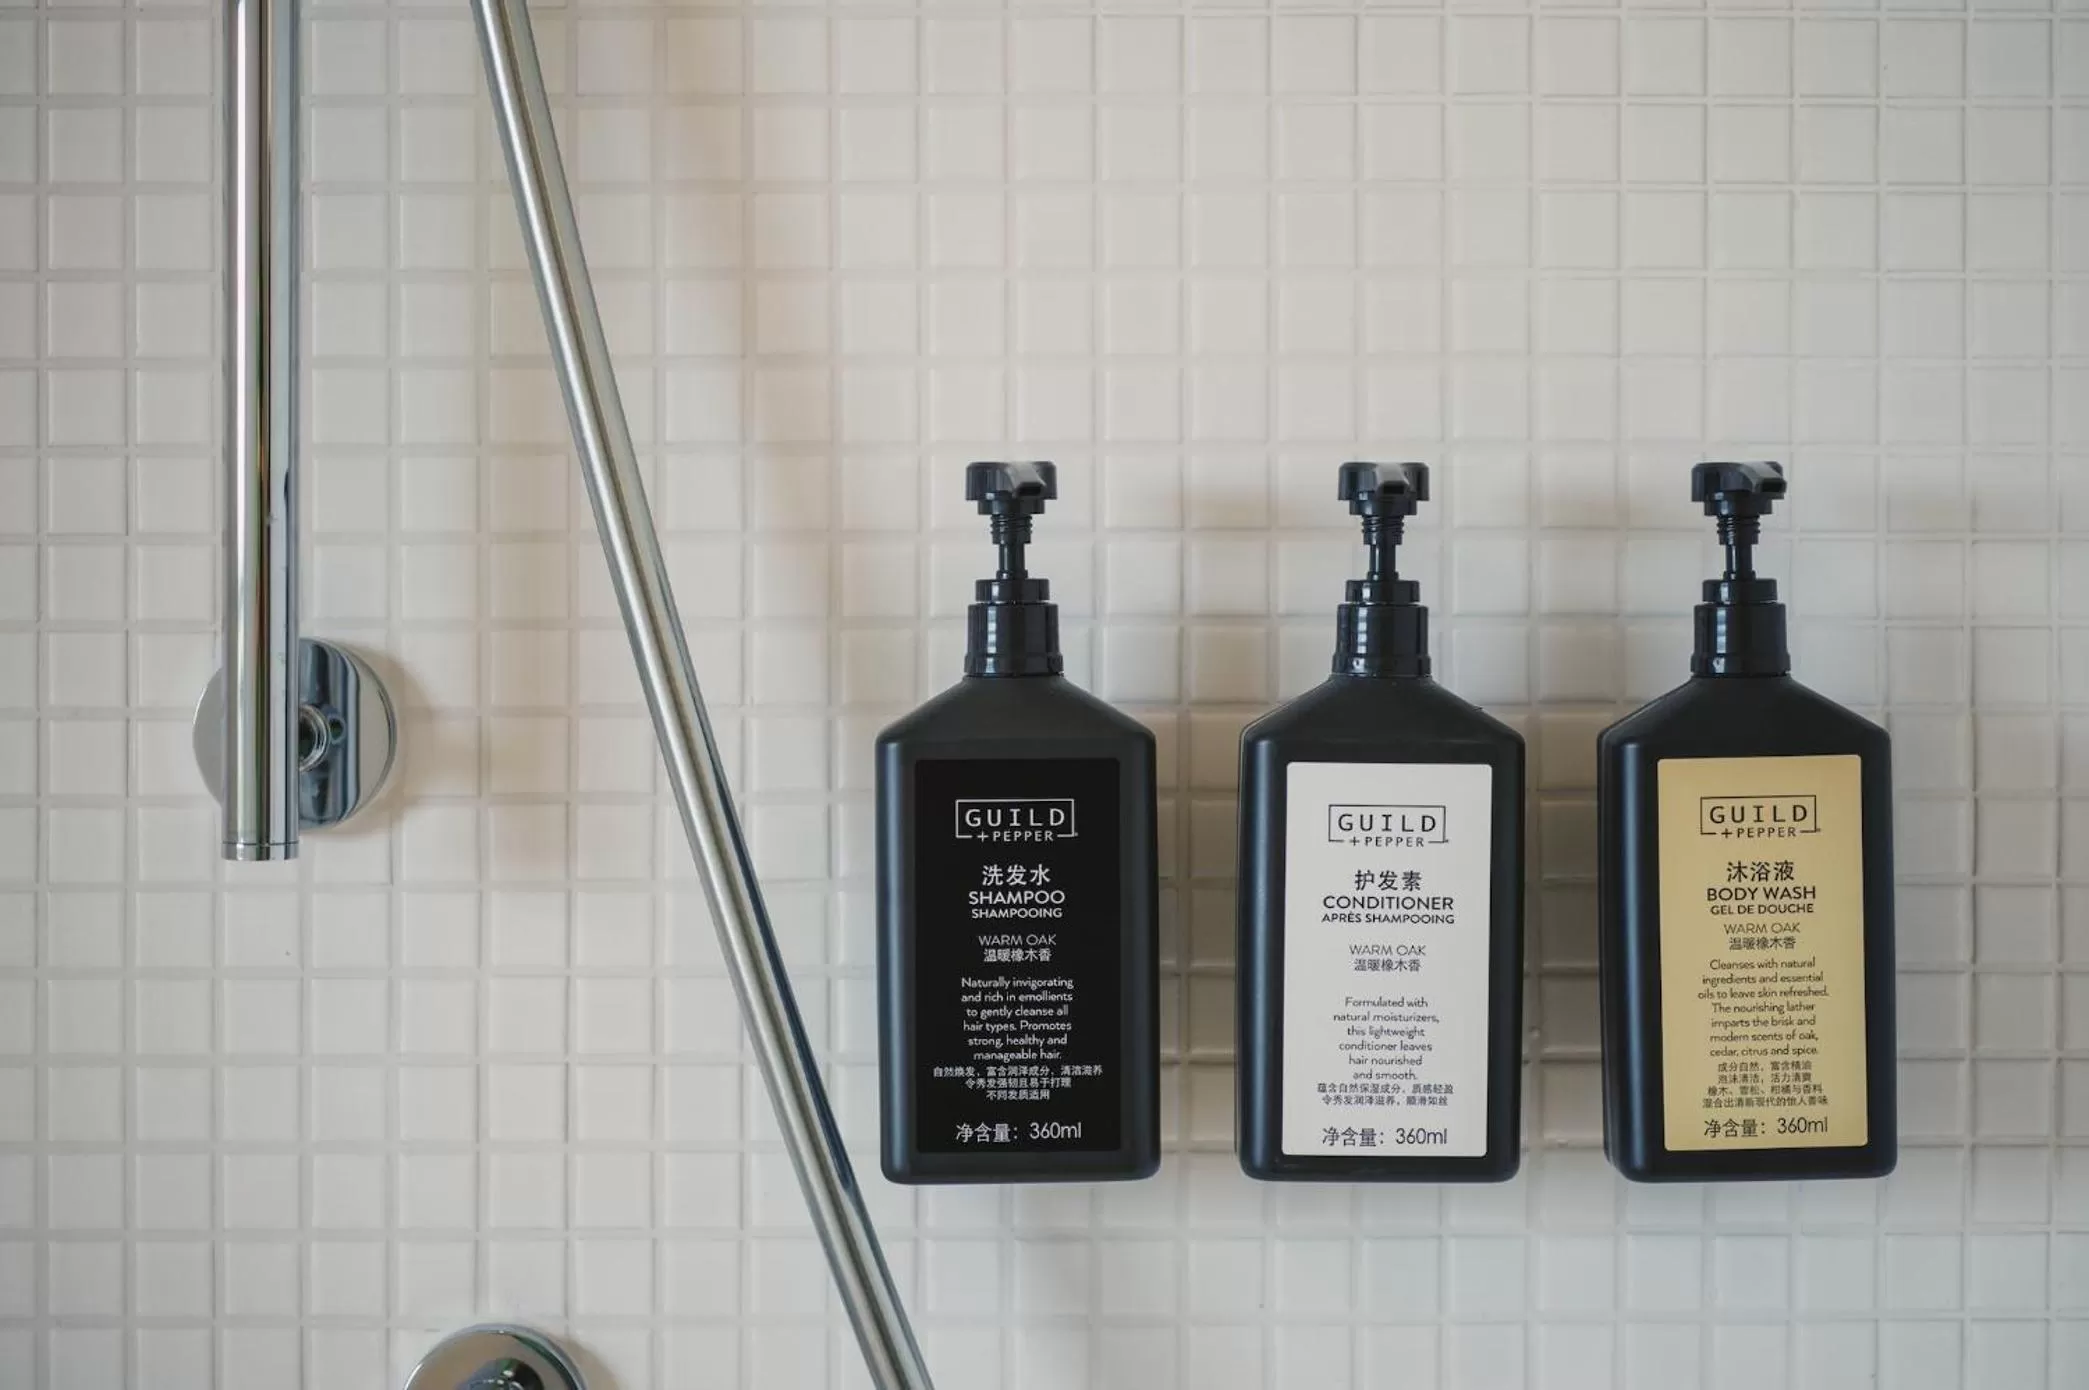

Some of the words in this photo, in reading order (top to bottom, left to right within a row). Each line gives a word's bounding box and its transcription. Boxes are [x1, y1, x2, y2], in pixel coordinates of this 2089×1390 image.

[965, 808, 1065, 827] GUILD
[1709, 805, 1807, 823] GUILD
[1338, 814, 1436, 832] GUILD
[982, 864, 1051, 886] 洗发水
[1727, 861, 1795, 882] 沐浴液
[1355, 870, 1422, 891] 护发素
[969, 890, 1065, 905] SHAMPOO
[1707, 888, 1760, 901] BODY
[1763, 886, 1816, 900] WASH
[1323, 896, 1453, 910] CONDITIONER
[1711, 905, 1734, 915] GEL
[1738, 905, 1754, 915] DE
[1758, 904, 1814, 914] DOUCHE
[972, 908, 1062, 918] SHAMPOOING
[1322, 911, 1362, 923] APRÈS
[1365, 914, 1454, 924] SHAMPOOING
[1724, 924, 1768, 934] WARM
[1771, 923, 1800, 933] OAK
[978, 935, 1023, 946] WARM
[1026, 934, 1056, 945] OAK
[1729, 937, 1796, 951] 温暖橡木香
[984, 948, 1052, 962] 温暖橡木香
[1350, 945, 1393, 955] WARM
[1396, 945, 1426, 956] OAK
[1354, 958, 1421, 972] 温暖橡木香
[1710, 959, 1755, 970] Cleanses
[1757, 959, 1778, 969] with
[1781, 957, 1816, 968] natural
[961, 977, 1010, 989] Naturally
[1013, 977, 1074, 990] invigorating
[1702, 974, 1756, 987] ingredients
[1759, 974, 1778, 983] and
[1780, 973, 1823, 983] essential
[962, 992, 981, 1002] and
[985, 992, 1003, 1002] rich
[1007, 992, 1015, 1001] in
[1019, 991, 1073, 1001] emollients
[1698, 989, 1715, 999] oils
[1717, 990, 1728, 998] to
[1730, 989, 1755, 998] leave
[1757, 988, 1778, 997] skin
[1780, 987, 1829, 997] refreshed.
[1345, 997, 1404, 1007] Formulated
[1407, 998, 1428, 1007] with
[1712, 1003, 1731, 1013] The
[1733, 1003, 1784, 1014] nourishing
[1787, 1002, 1815, 1012] lather
[967, 1008, 977, 1016] to
[980, 1006, 1012, 1019] gently
[1015, 1006, 1053, 1016] cleanse
[1057, 1005, 1068, 1016] all
[1333, 1012, 1369, 1022] natural
[1373, 1013, 1440, 1023] moisturizers,
[963, 1021, 983, 1031] hair
[986, 1022, 1017, 1033] types.
[1020, 1021, 1072, 1031] Promotes
[1711, 1018, 1750, 1029] imparts
[1752, 1017, 1769, 1027] the
[1771, 1016, 1795, 1027] brisk
[1797, 1016, 1816, 1026] and
[1347, 1027, 1366, 1036] this
[1369, 1026, 1425, 1039] lightweight
[1710, 1032, 1749, 1042] modern
[1751, 1032, 1784, 1042] scents
[1786, 1030, 1797, 1041] of
[1799, 1032, 1819, 1042] oak,
[968, 1037, 1004, 1047] strong,
[1007, 1035, 1044, 1047] healthy
[1047, 1034, 1067, 1044] and
[1339, 1041, 1397, 1051] conditioner
[1400, 1042, 1432, 1052] leaves
[974, 1050, 1037, 1062] manageable
[1040, 1049, 1062, 1059] hair.
[1710, 1046, 1739, 1057] cedar,
[1741, 1047, 1768, 1056] citrus
[1771, 1045, 1789, 1055] and
[1792, 1045, 1818, 1057] spice.
[1349, 1055, 1368, 1065] hair
[1371, 1056, 1422, 1066] nourished
[1353, 1070, 1373, 1080] and
[1375, 1070, 1417, 1080] smooth.
[1030, 1122, 1082, 1139] 360ml
[1777, 1117, 1828, 1135] 360ml
[1396, 1128, 1447, 1145] 360ml
